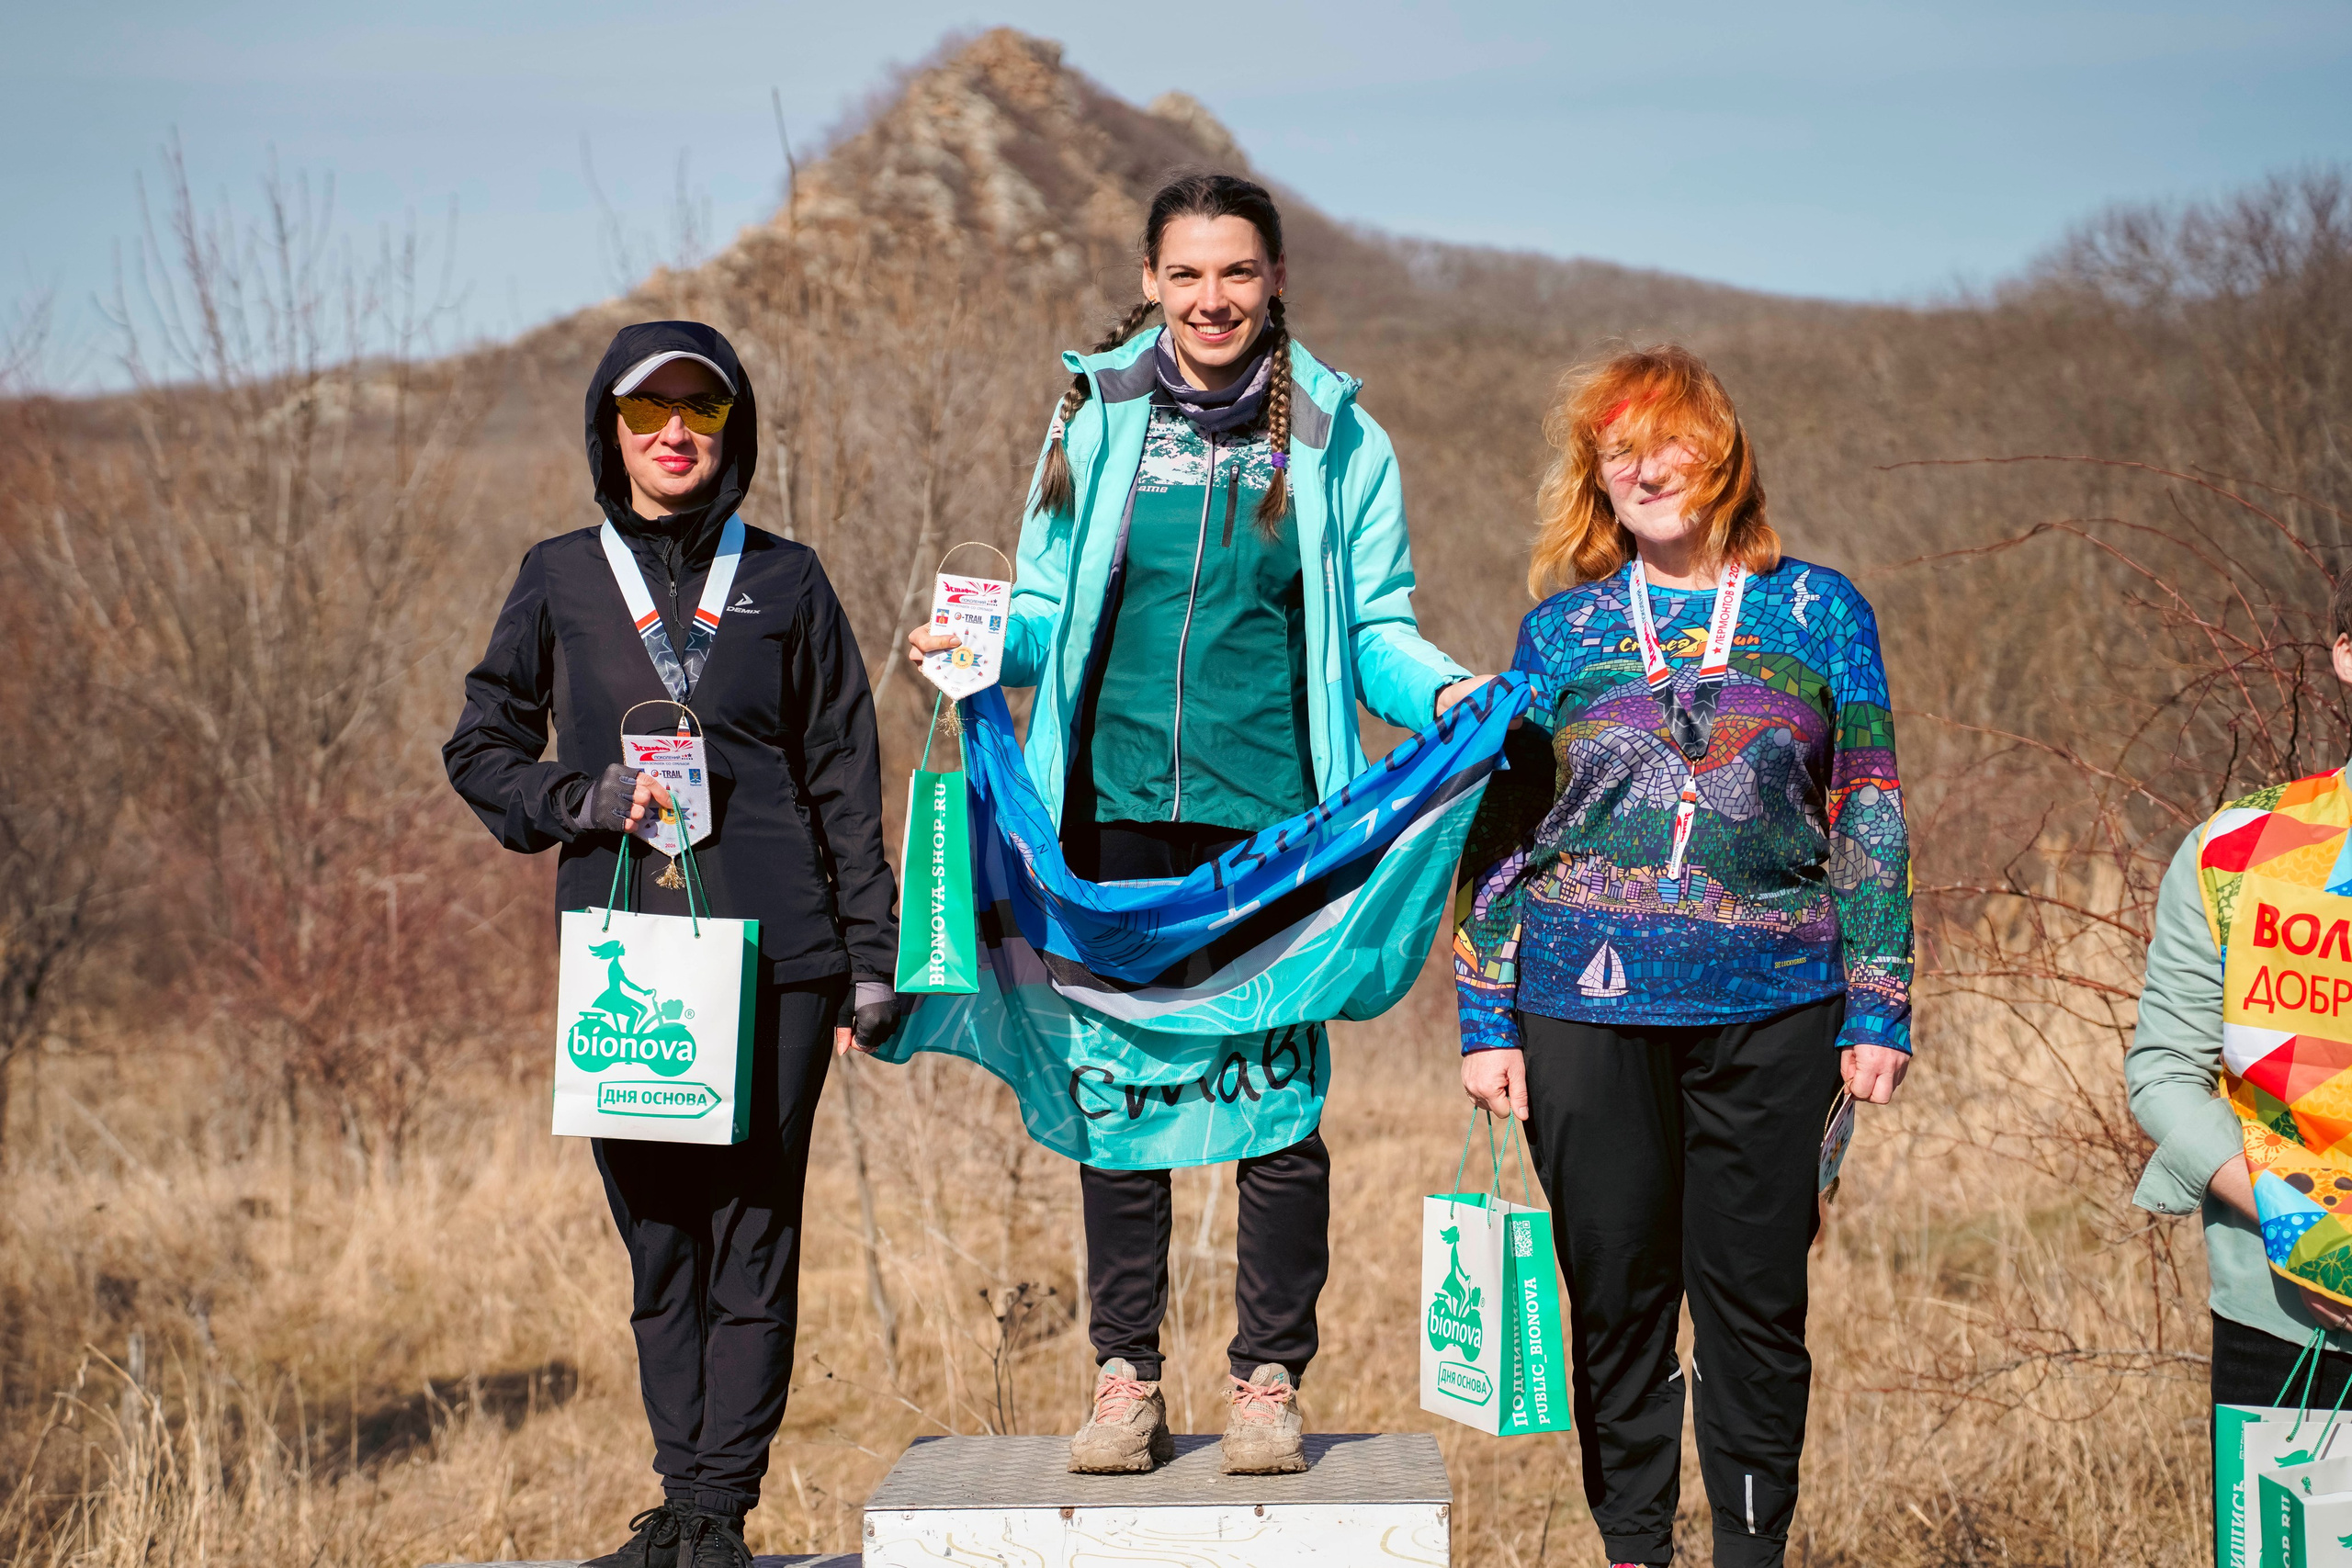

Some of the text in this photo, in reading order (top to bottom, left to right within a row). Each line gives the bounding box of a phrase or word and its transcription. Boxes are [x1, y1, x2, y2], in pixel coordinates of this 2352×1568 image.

[726, 606, 762, 615] DEMIX
[1714, 558, 1742, 646] ЛЕРМОНТОВ 202
[929, 783, 946, 987] BIONOVA-SHOP.RU
[2243, 965, 2352, 1018] ДОБР
[572, 1026, 694, 1062] bionova
[604, 1089, 707, 1107] ДНЯ ОСНОВА
[1430, 1305, 1482, 1348] bionova
[1523, 1277, 1551, 1425] PUBLIC_BIONOVA
[1440, 1367, 1487, 1395] ДНЯ ОСНОВА
